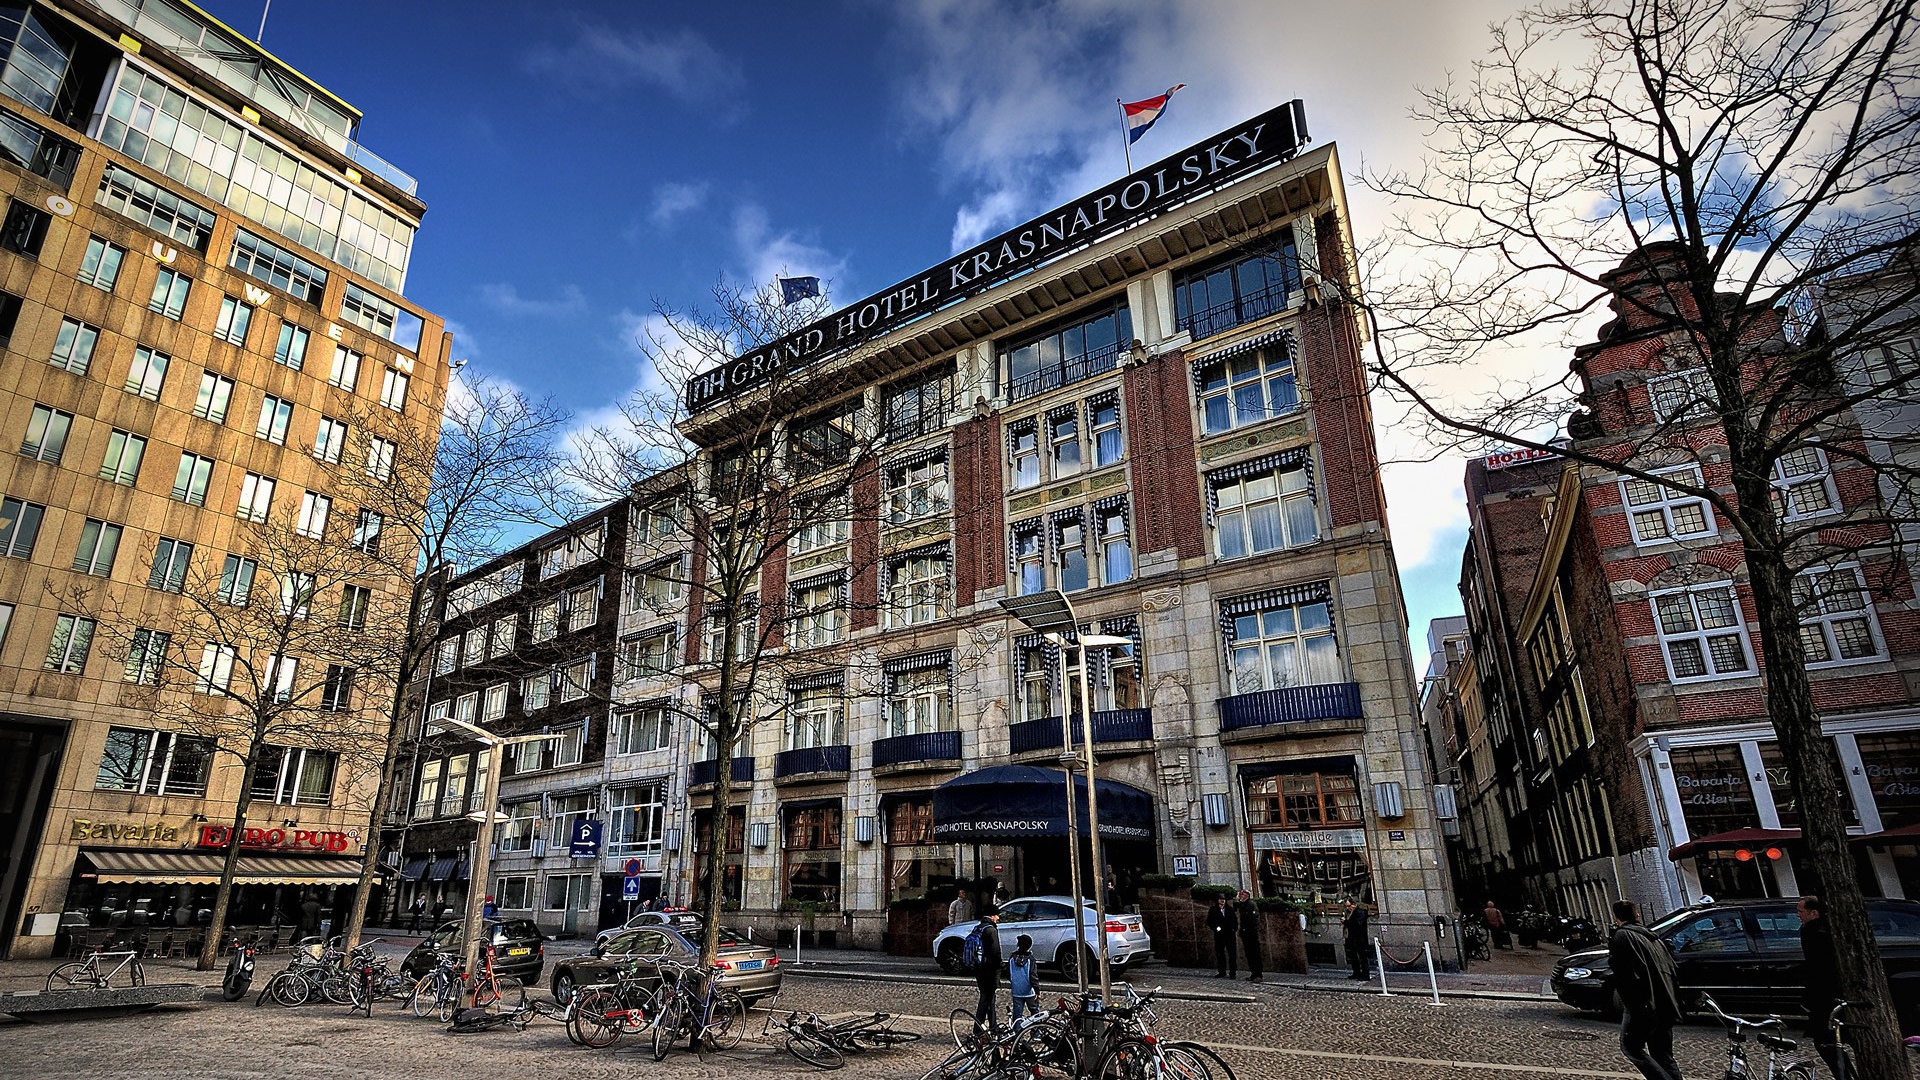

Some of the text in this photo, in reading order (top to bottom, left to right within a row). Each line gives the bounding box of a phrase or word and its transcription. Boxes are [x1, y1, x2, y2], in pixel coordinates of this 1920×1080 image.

[732, 328, 823, 386] GRAND
[836, 276, 939, 340] HOTEL
[949, 123, 1266, 290] KRASNAPOLSKY
[1677, 773, 1743, 788] Bavaria
[69, 819, 178, 842] Bavaria
[949, 822, 973, 832] HOTEL
[975, 820, 1049, 831] KRASNAPOLSKY
[293, 829, 348, 852] PUB
[581, 829, 590, 840] P
[1283, 831, 1333, 844] Mathilde
[1176, 858, 1192, 868] nH
